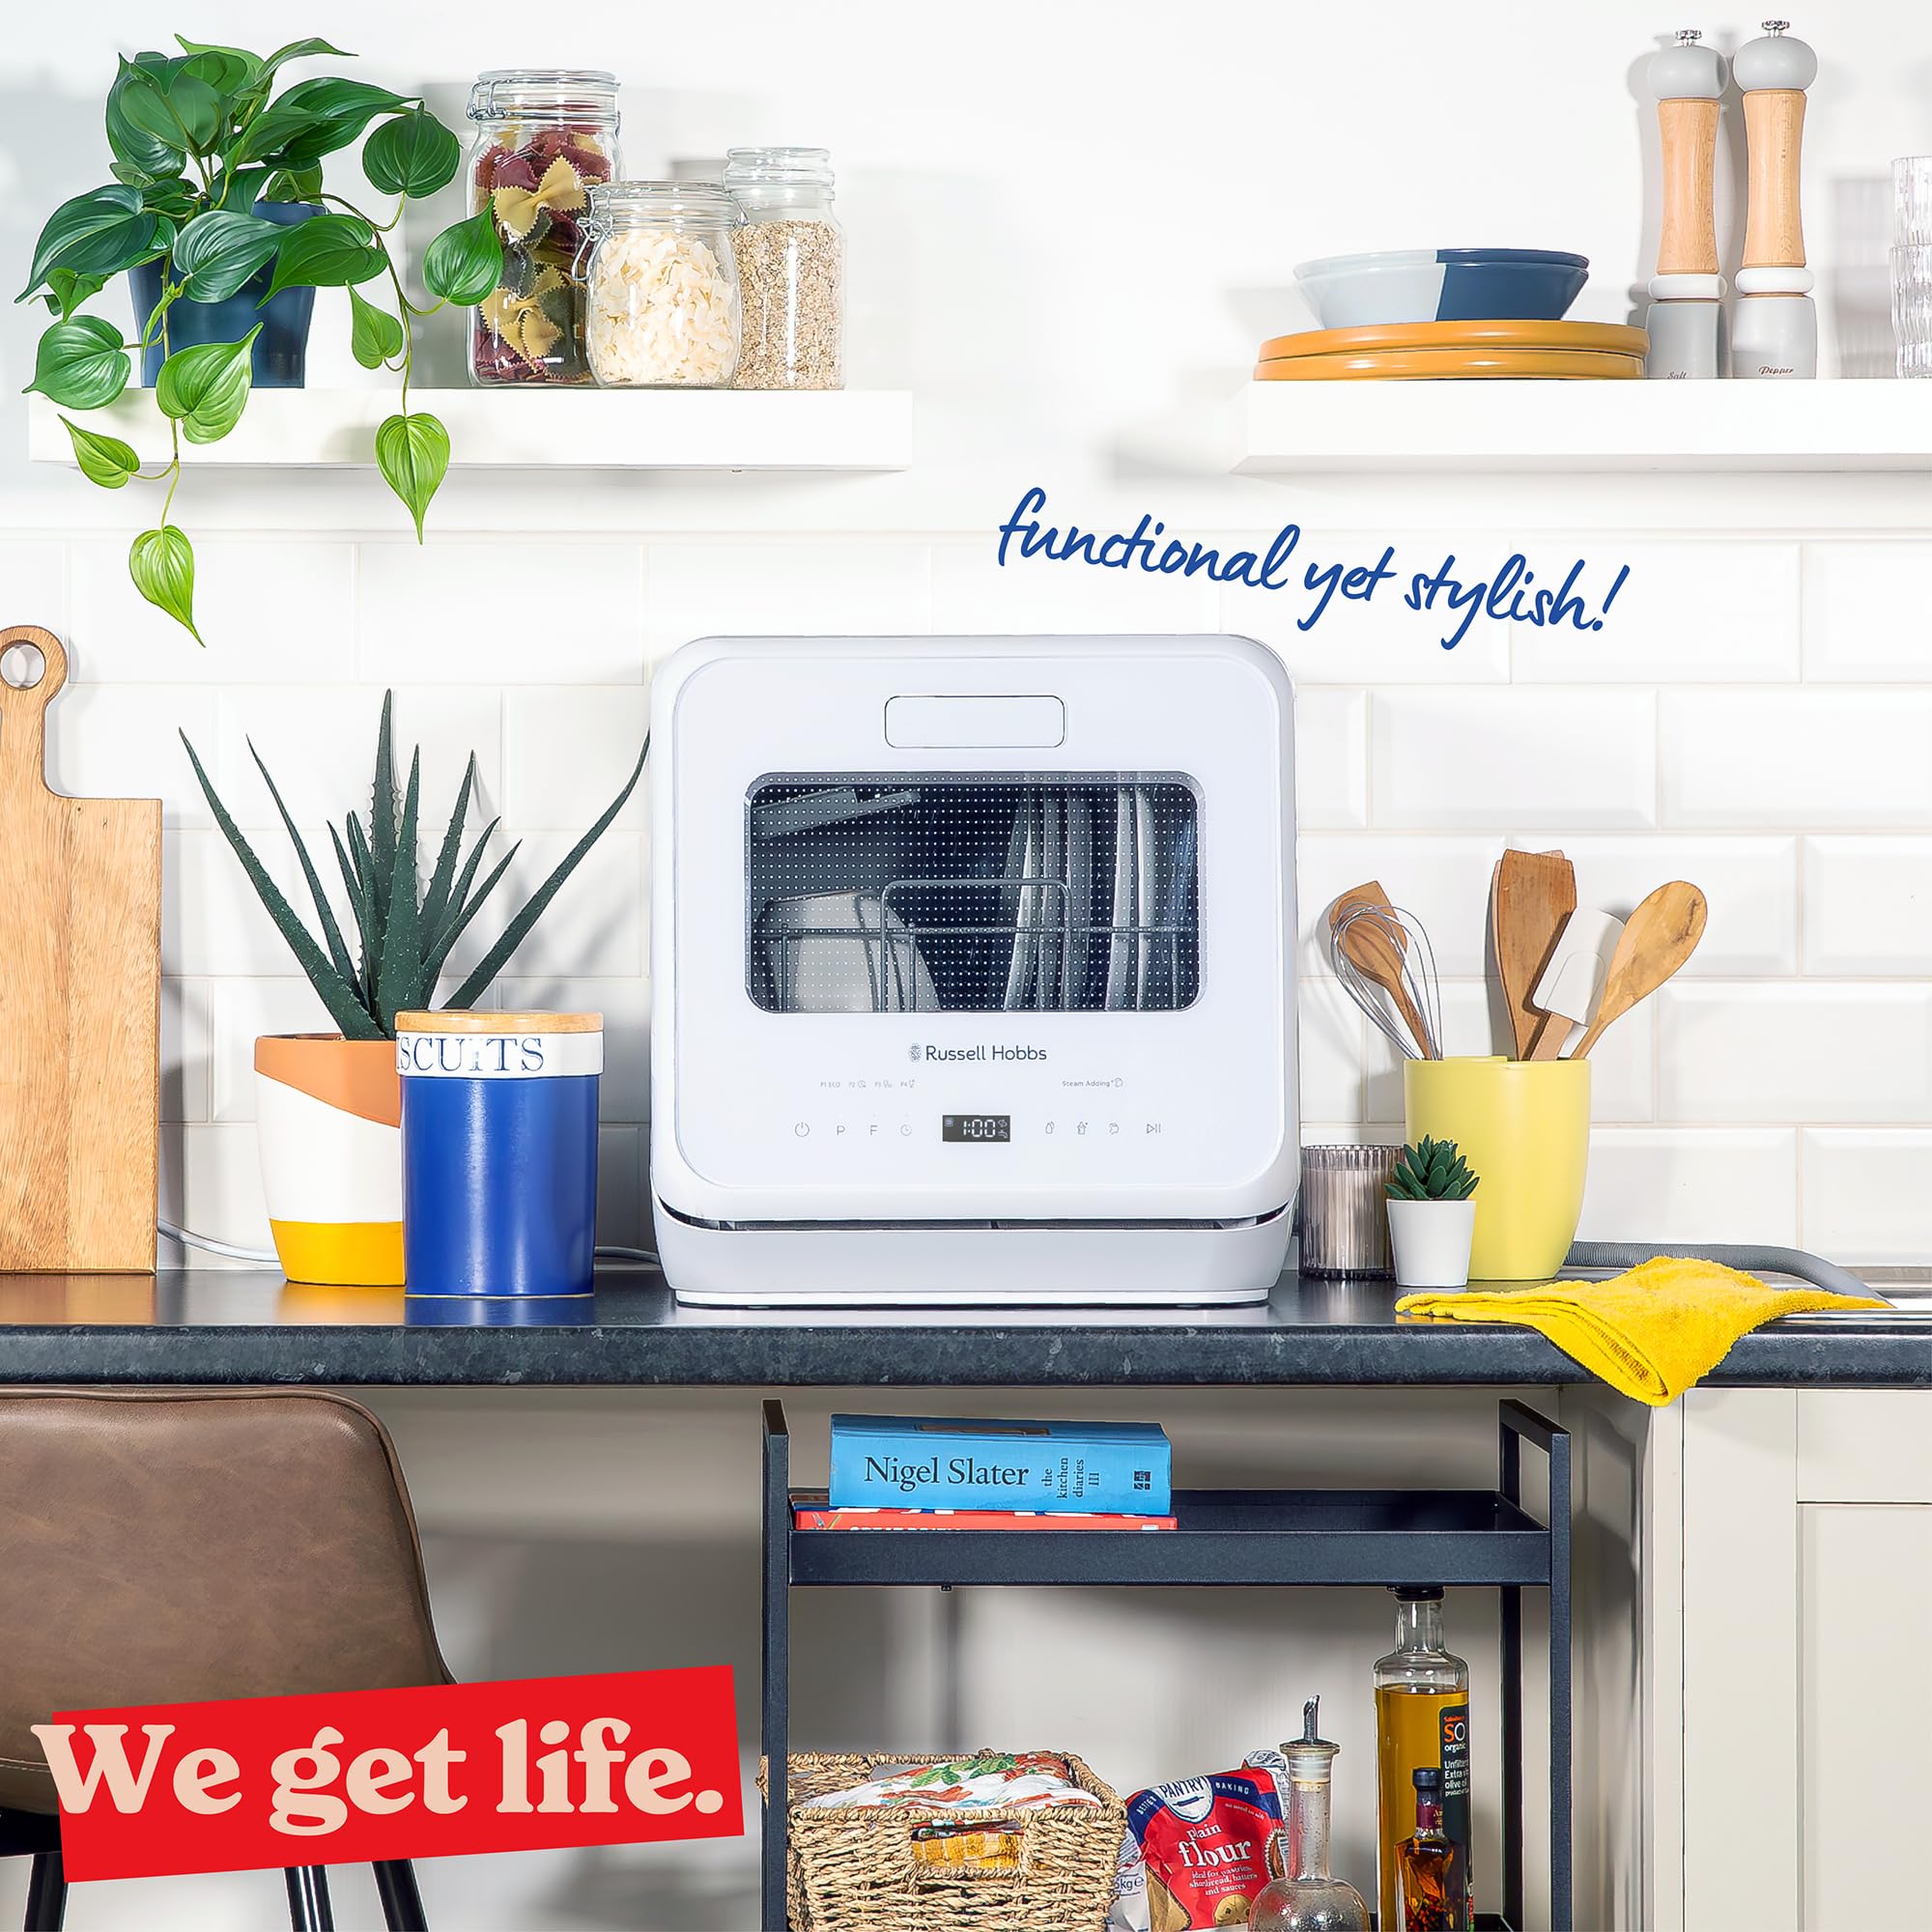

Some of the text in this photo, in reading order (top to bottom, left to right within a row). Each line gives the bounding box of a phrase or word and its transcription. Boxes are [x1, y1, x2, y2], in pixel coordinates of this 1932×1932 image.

[1667, 371, 1688, 380] Salt
[1758, 366, 1794, 376] Pepper
[925, 1044, 1047, 1062] Russell Hobbs
[837, 1124, 845, 1136] P
[869, 1124, 878, 1136] F
[963, 1119, 996, 1138] 1:00
[864, 1457, 1030, 1492] Nigel Slater
[1040, 1467, 1053, 1487] the
[1057, 1457, 1068, 1499] kitchen
[1072, 1459, 1085, 1498] diaries
[1088, 1472, 1100, 1487] III
[1444, 1722, 1465, 1743] SO
[1445, 1770, 1463, 1779] Extra
[1159, 1776, 1206, 1799] PANTRY
[1215, 1781, 1250, 1795] BAKING
[1444, 1779, 1462, 1790] olive
[1186, 1823, 1222, 1840] plain
[1178, 1839, 1253, 1868] flour
[1205, 1883, 1246, 1895] and sauces
